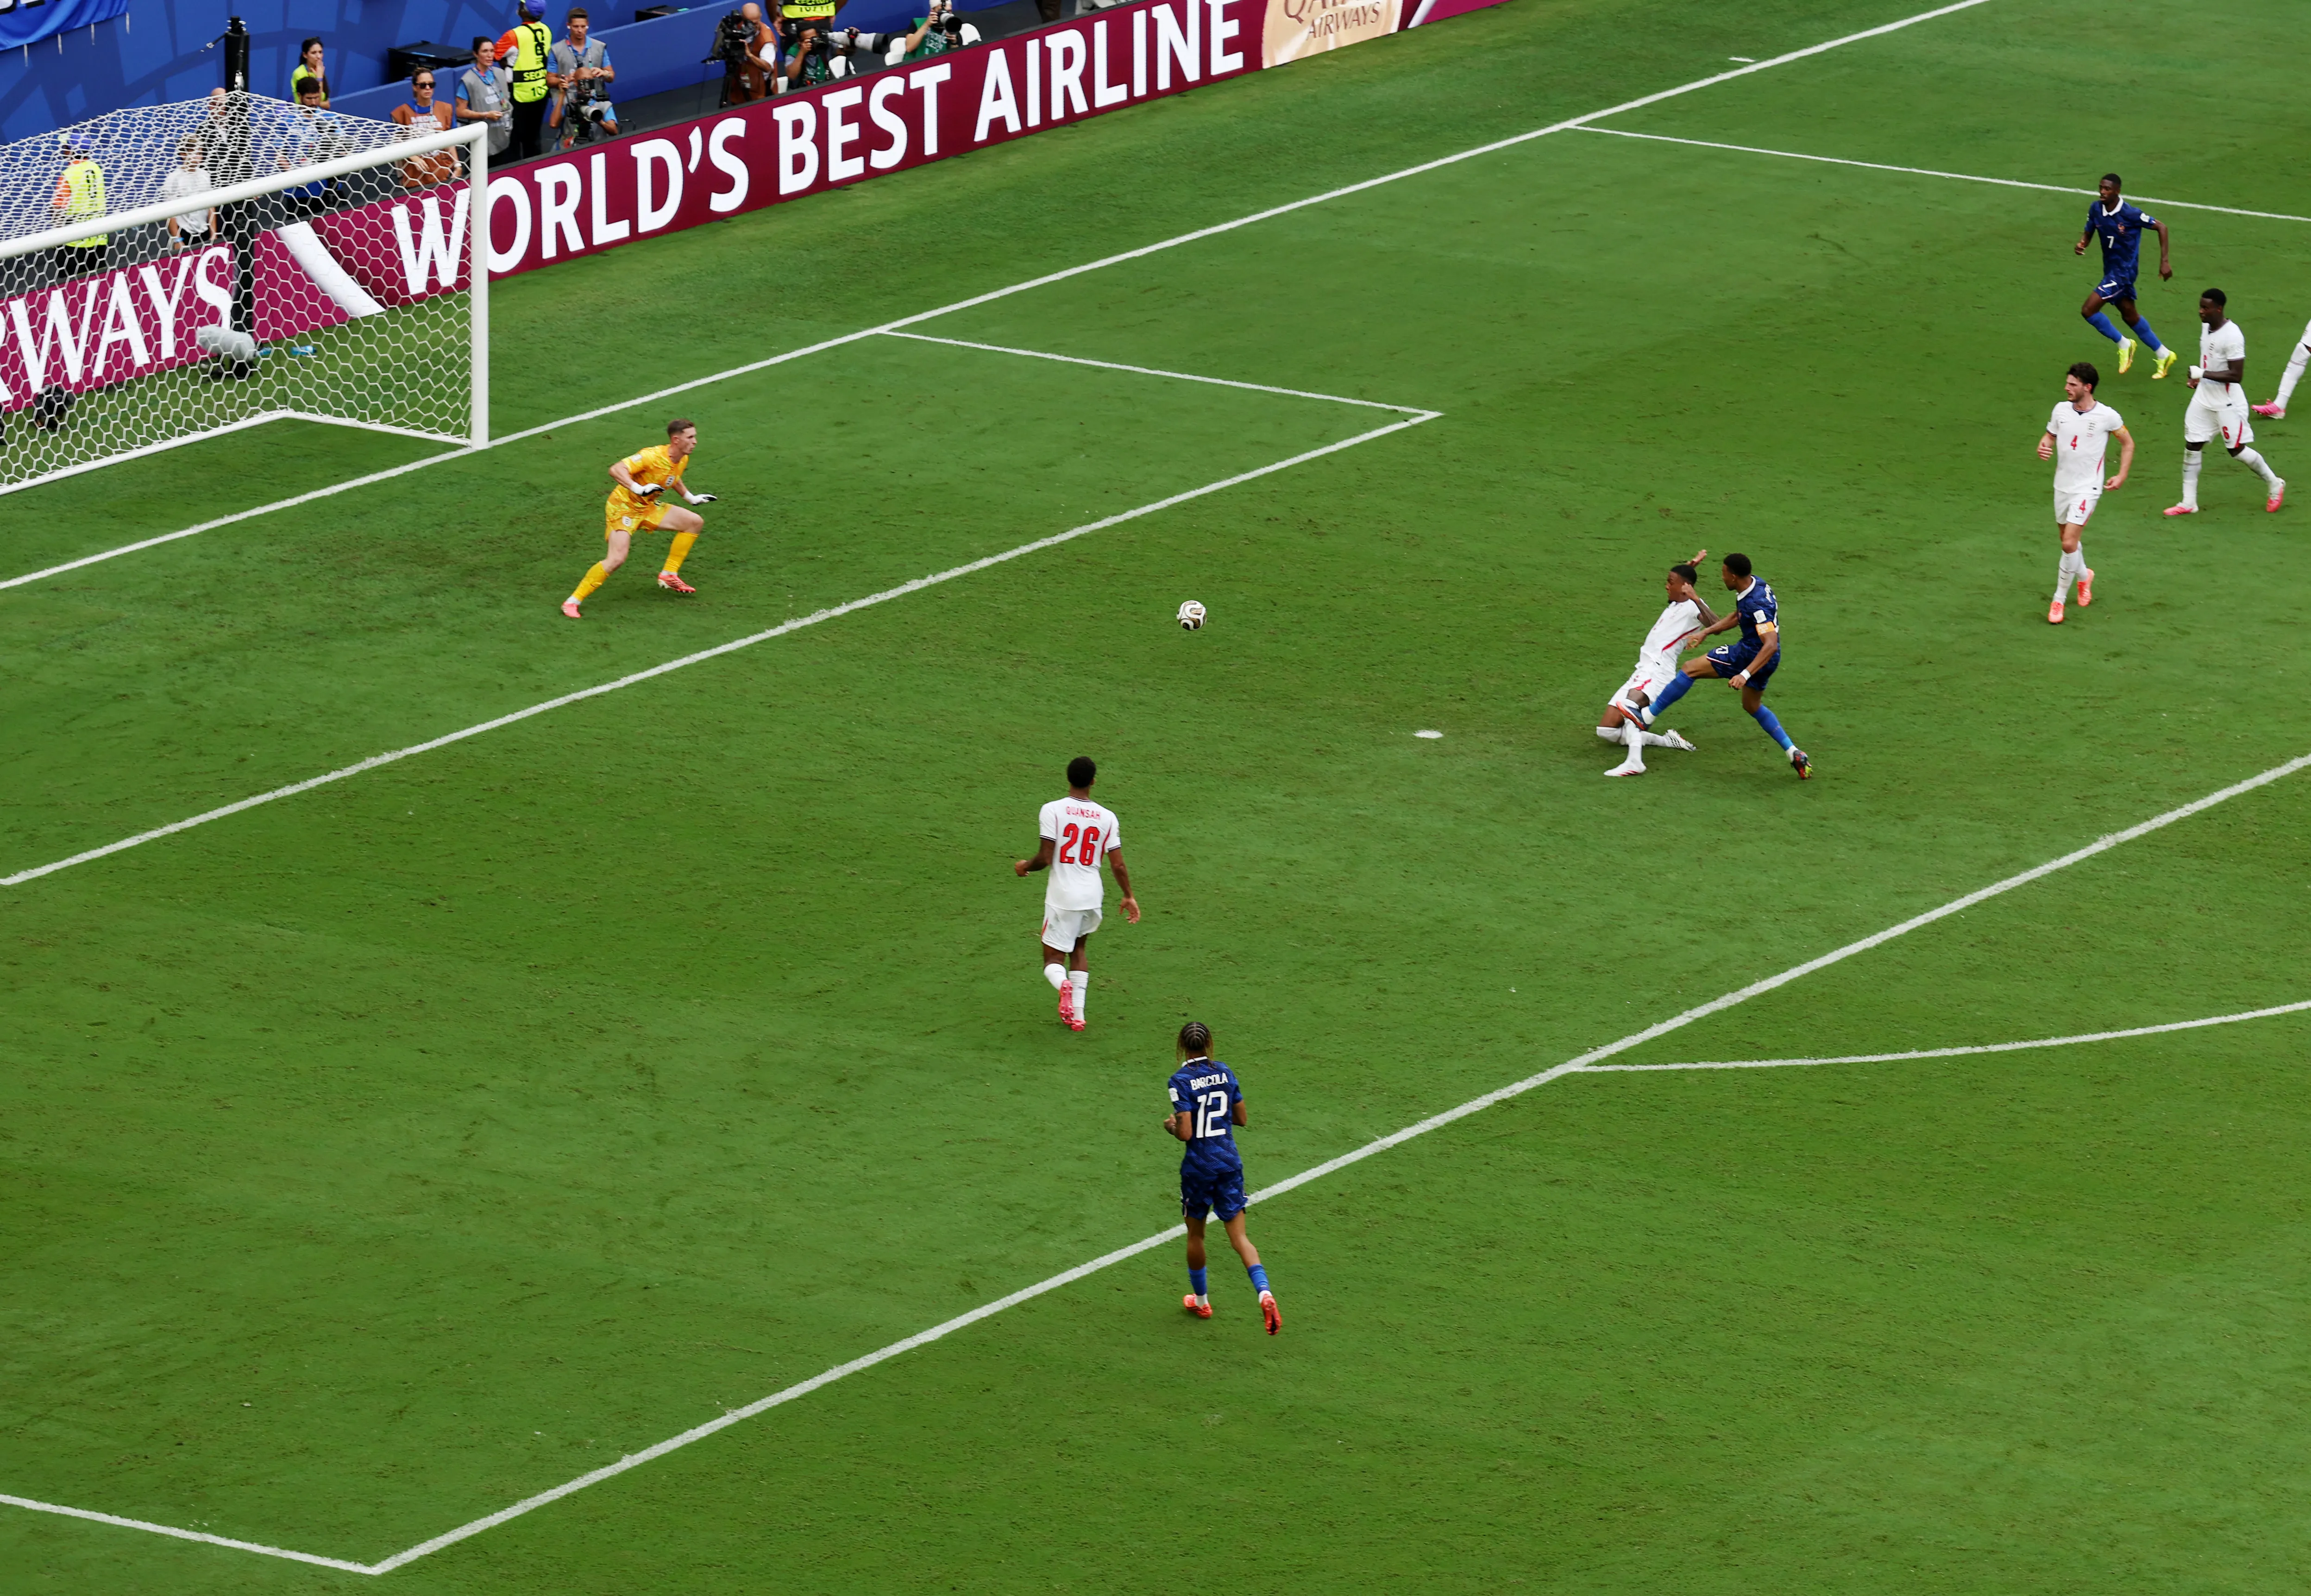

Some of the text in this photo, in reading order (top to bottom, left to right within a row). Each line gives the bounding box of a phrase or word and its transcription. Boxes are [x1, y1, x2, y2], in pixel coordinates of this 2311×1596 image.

[1306, 1, 1380, 41] AIRWAYS
[391, 0, 1244, 295] WORLD'S BEST AIRLINE
[2107, 236, 2115, 249] 7
[2102, 280, 2117, 288] 7
[0, 246, 232, 402] WAYS
[2222, 426, 2230, 440] 6
[2070, 435, 2078, 451] 4
[2078, 499, 2086, 514] 4
[1066, 806, 1101, 820] QUANSAH
[1060, 823, 1100, 867] 26
[1190, 1072, 1229, 1091] BARCOLA
[1196, 1091, 1228, 1138] 12
